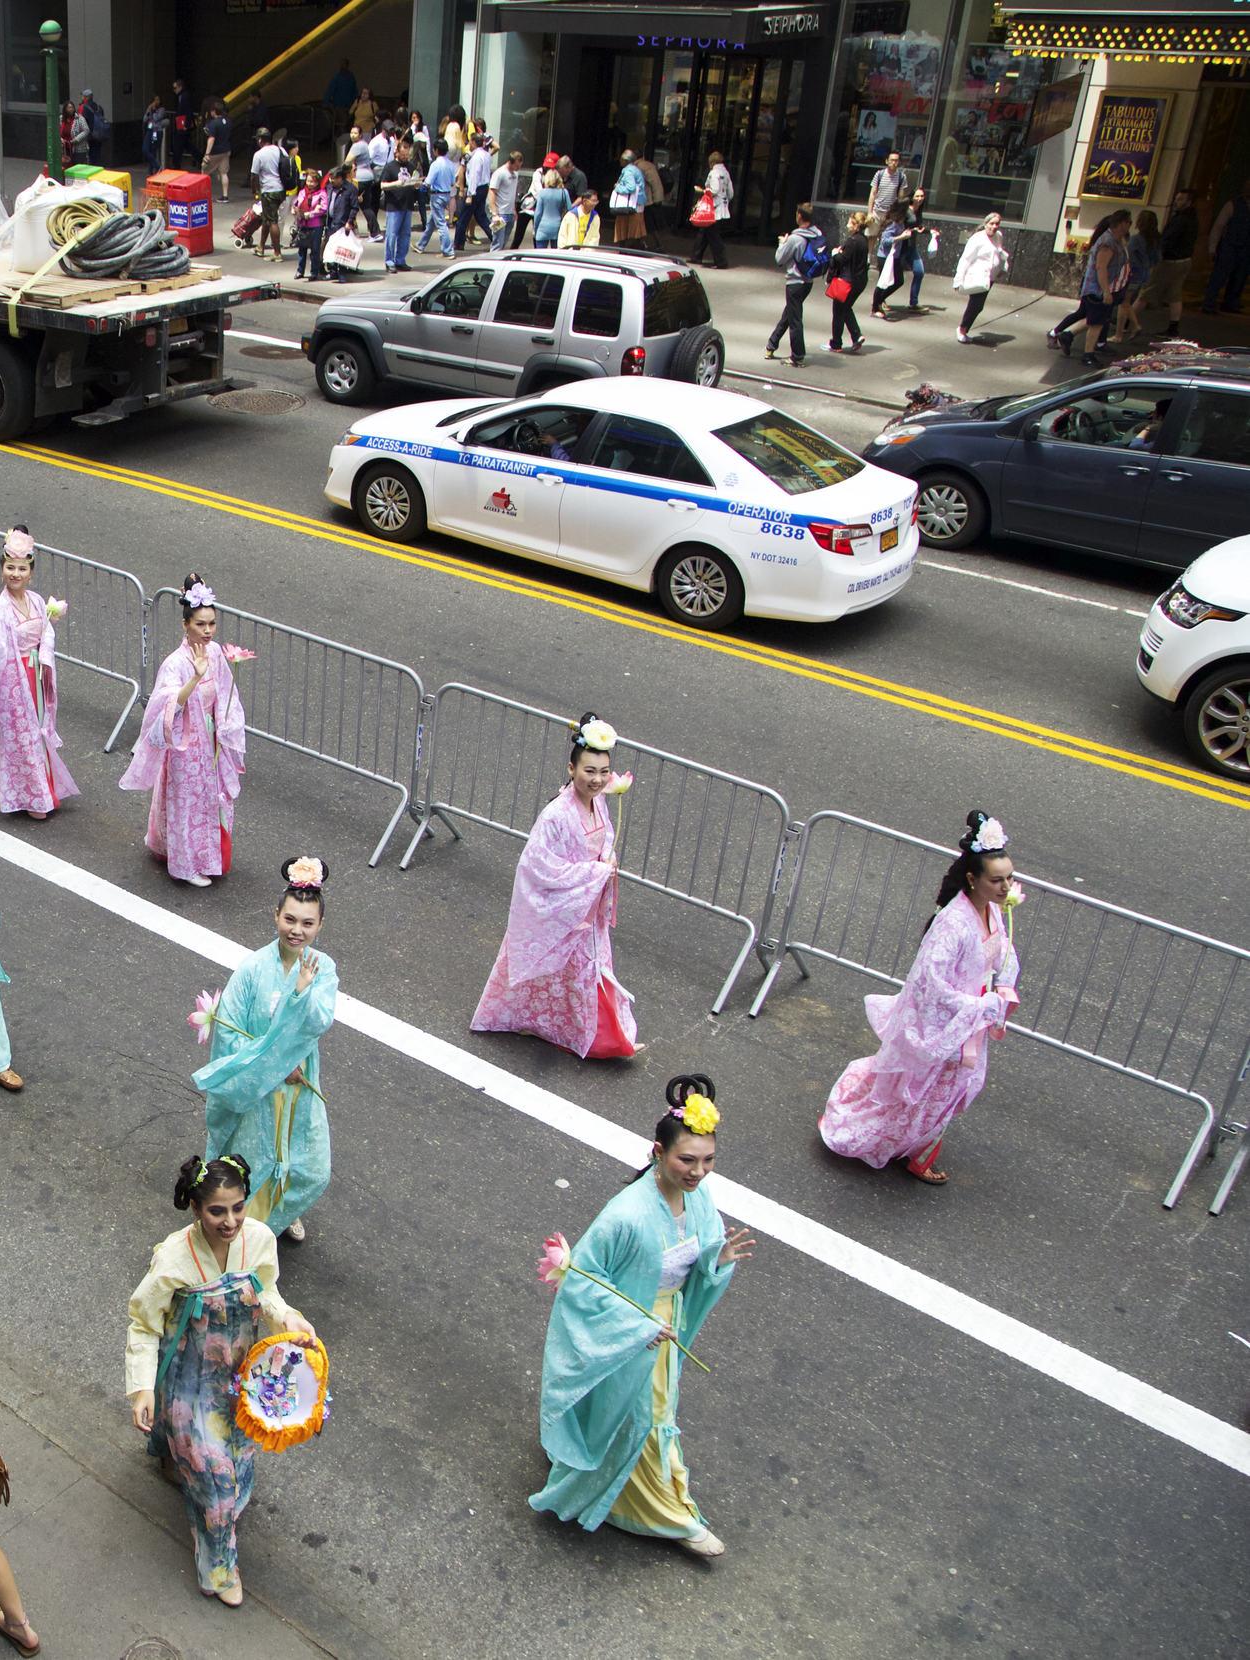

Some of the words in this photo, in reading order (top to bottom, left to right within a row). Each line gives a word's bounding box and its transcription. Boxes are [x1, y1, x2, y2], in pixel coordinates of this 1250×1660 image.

[764, 13, 819, 36] SEPHORA
[1101, 127, 1113, 139] IT
[1115, 128, 1154, 143] DEFIES
[1086, 159, 1149, 185] Aladdin
[170, 204, 188, 216] VOICE
[191, 203, 207, 215] VOICE
[366, 436, 433, 458] ACCESS-A-RIDE
[458, 452, 471, 465] TC
[471, 456, 537, 476] PARATRANSIT
[728, 501, 793, 524] OPERATOR
[871, 507, 893, 525] 8638
[760, 522, 805, 540] 8638
[750, 551, 761, 560] NY
[762, 553, 777, 562] DOT
[778, 555, 798, 566] 32416
